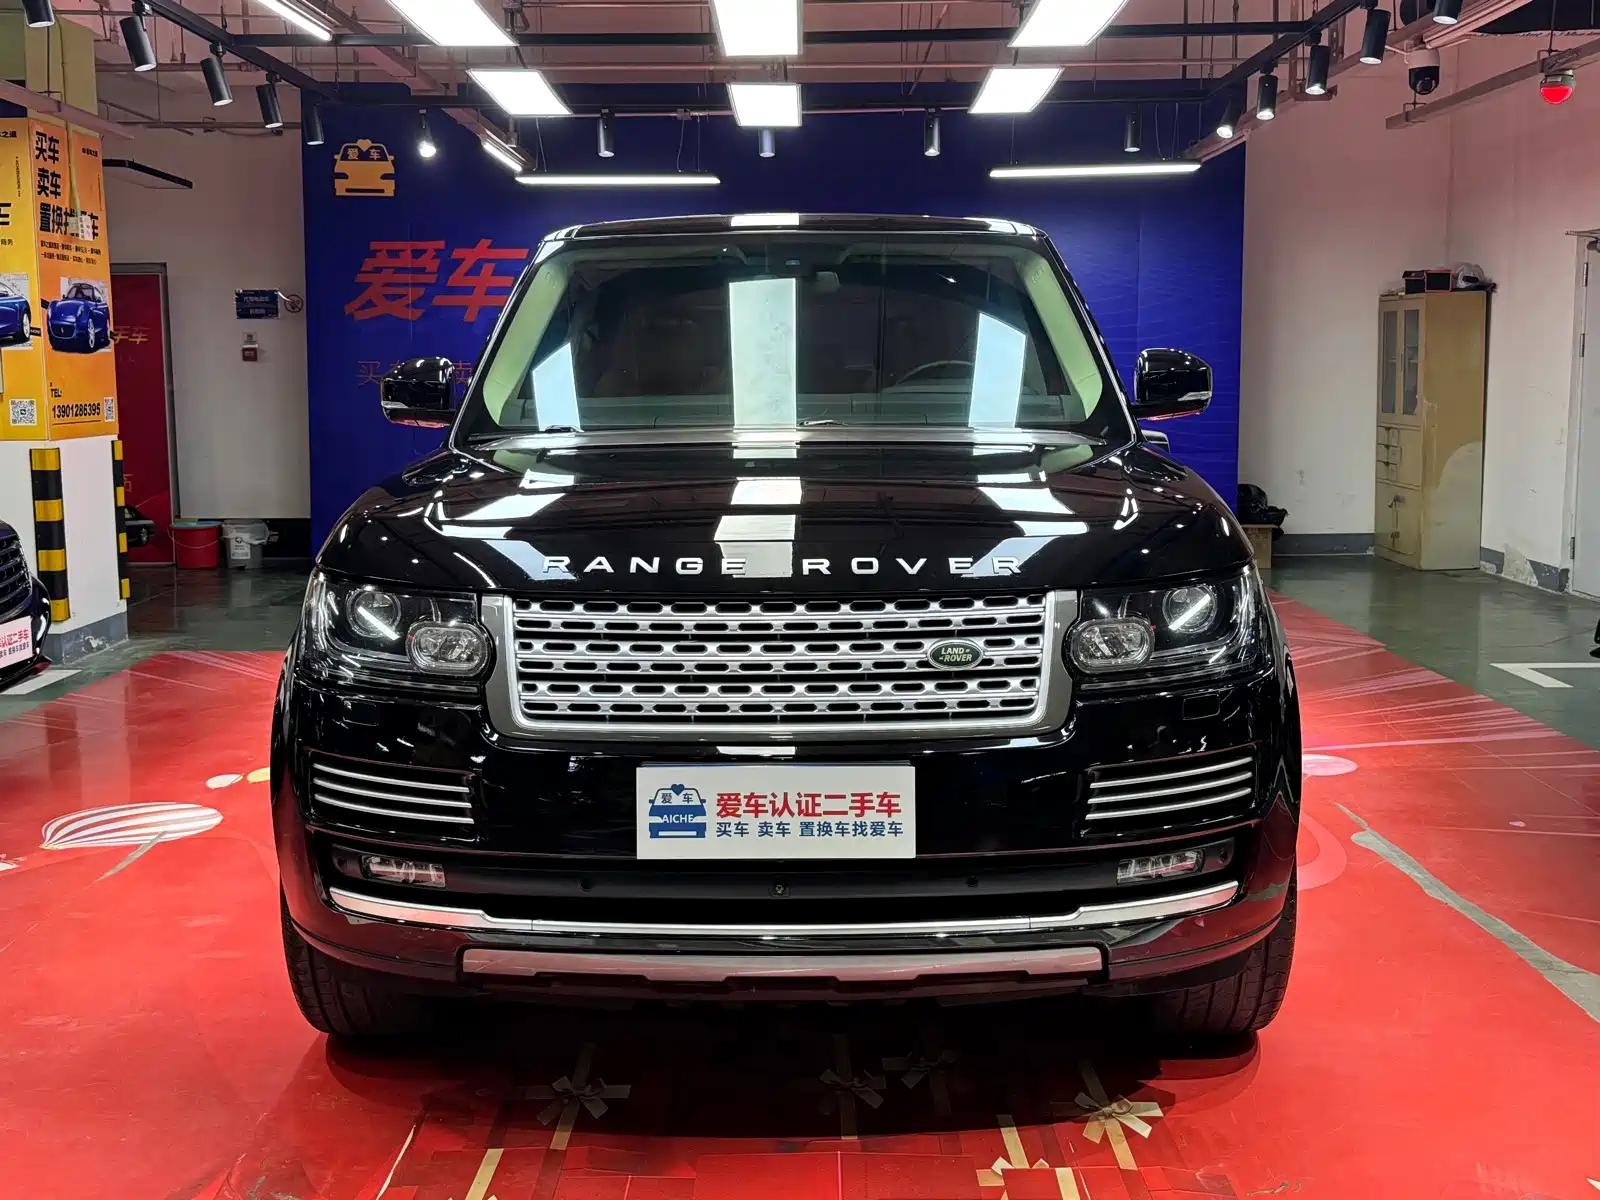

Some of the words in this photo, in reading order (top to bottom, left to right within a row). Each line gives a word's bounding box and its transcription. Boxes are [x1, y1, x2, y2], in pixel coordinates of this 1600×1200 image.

[35, 131, 60, 164] 买车
[37, 167, 62, 199] 卖车
[39, 202, 100, 241] 置换找车
[344, 239, 529, 323] 爱车
[50, 388, 63, 398] TEL:
[52, 403, 101, 419] 13901286395
[542, 555, 747, 576] RANGE
[802, 555, 1021, 576] ROVER
[941, 647, 965, 655] LAND
[943, 653, 973, 662] ROVER
[716, 791, 902, 819] 爱车认证二手车
[662, 813, 694, 824] AICHE
[715, 821, 750, 838] 买车
[757, 821, 792, 838] 卖车
[799, 820, 904, 838] 置换车找爱车
